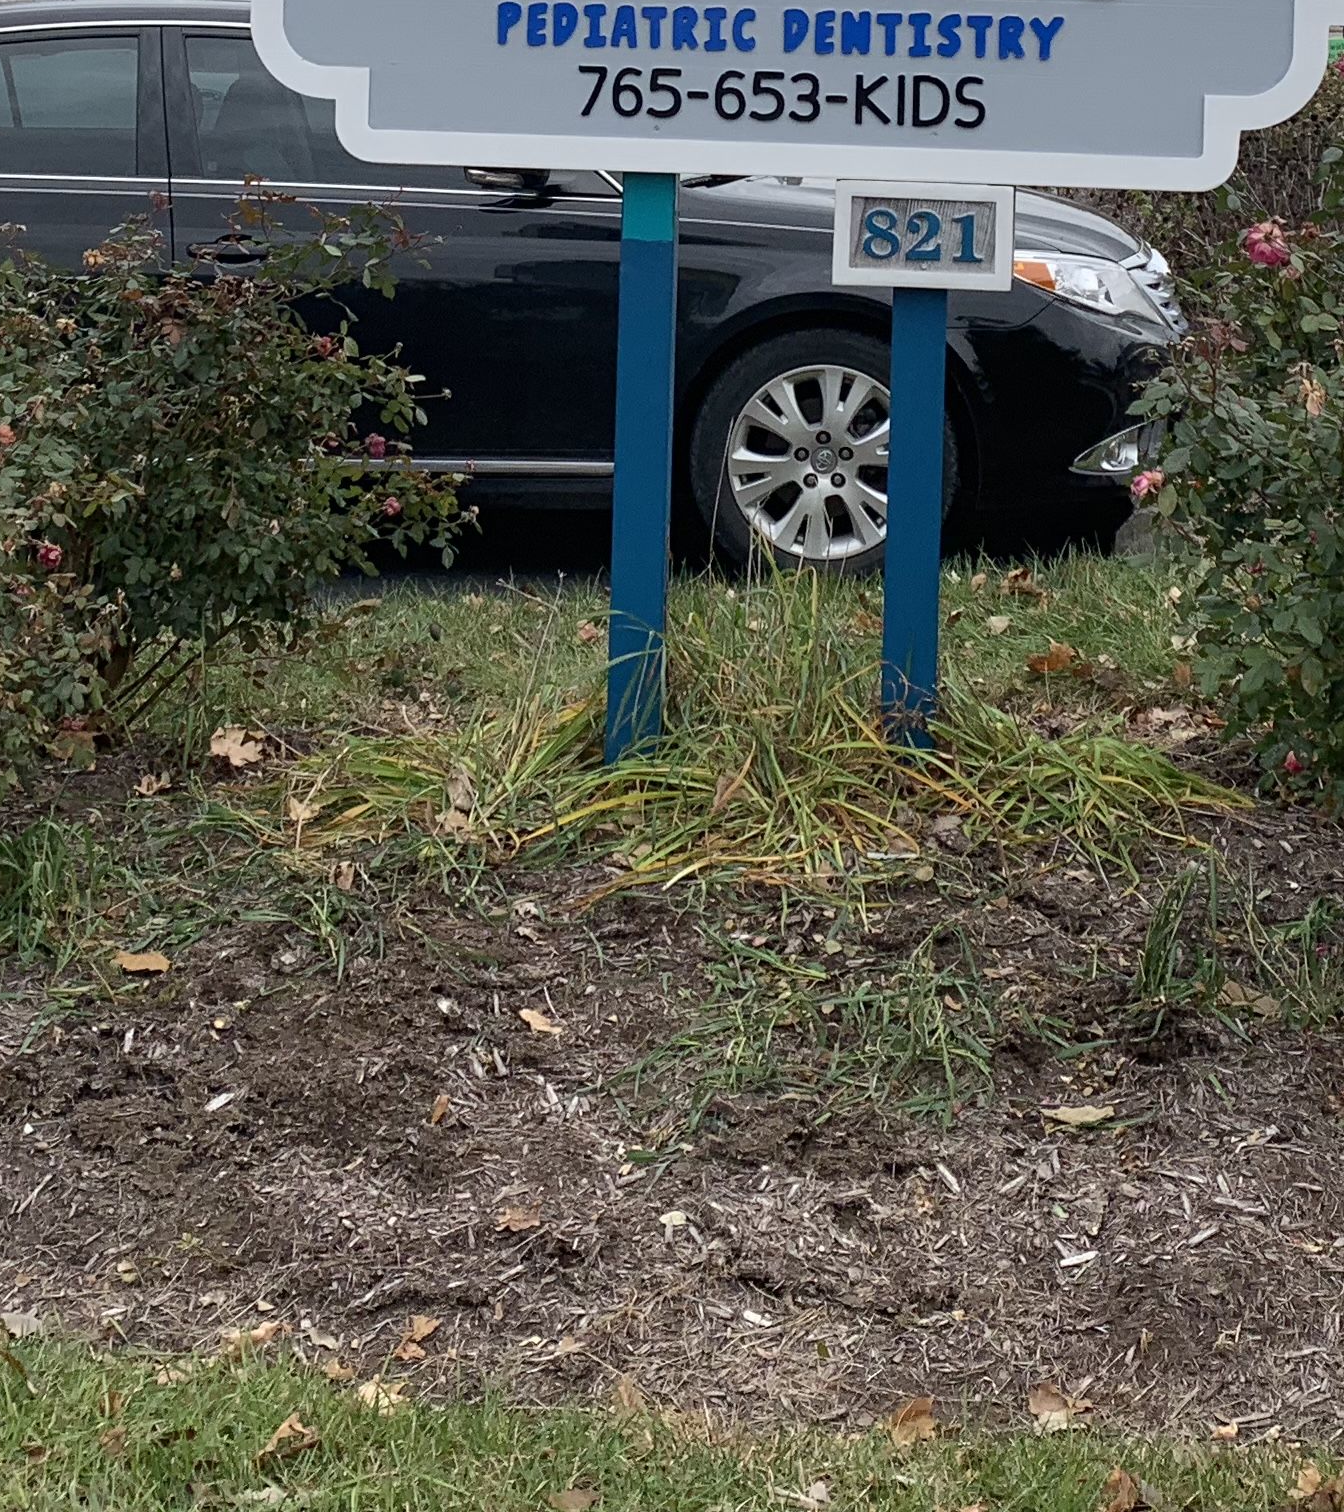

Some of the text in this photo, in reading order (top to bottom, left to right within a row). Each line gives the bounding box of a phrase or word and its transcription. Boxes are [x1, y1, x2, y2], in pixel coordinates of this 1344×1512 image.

[497, 1, 1065, 60] PEDIATRIC DENTISTRY
[578, 65, 986, 130] 765-653-KIDS
[862, 209, 984, 263] 821
